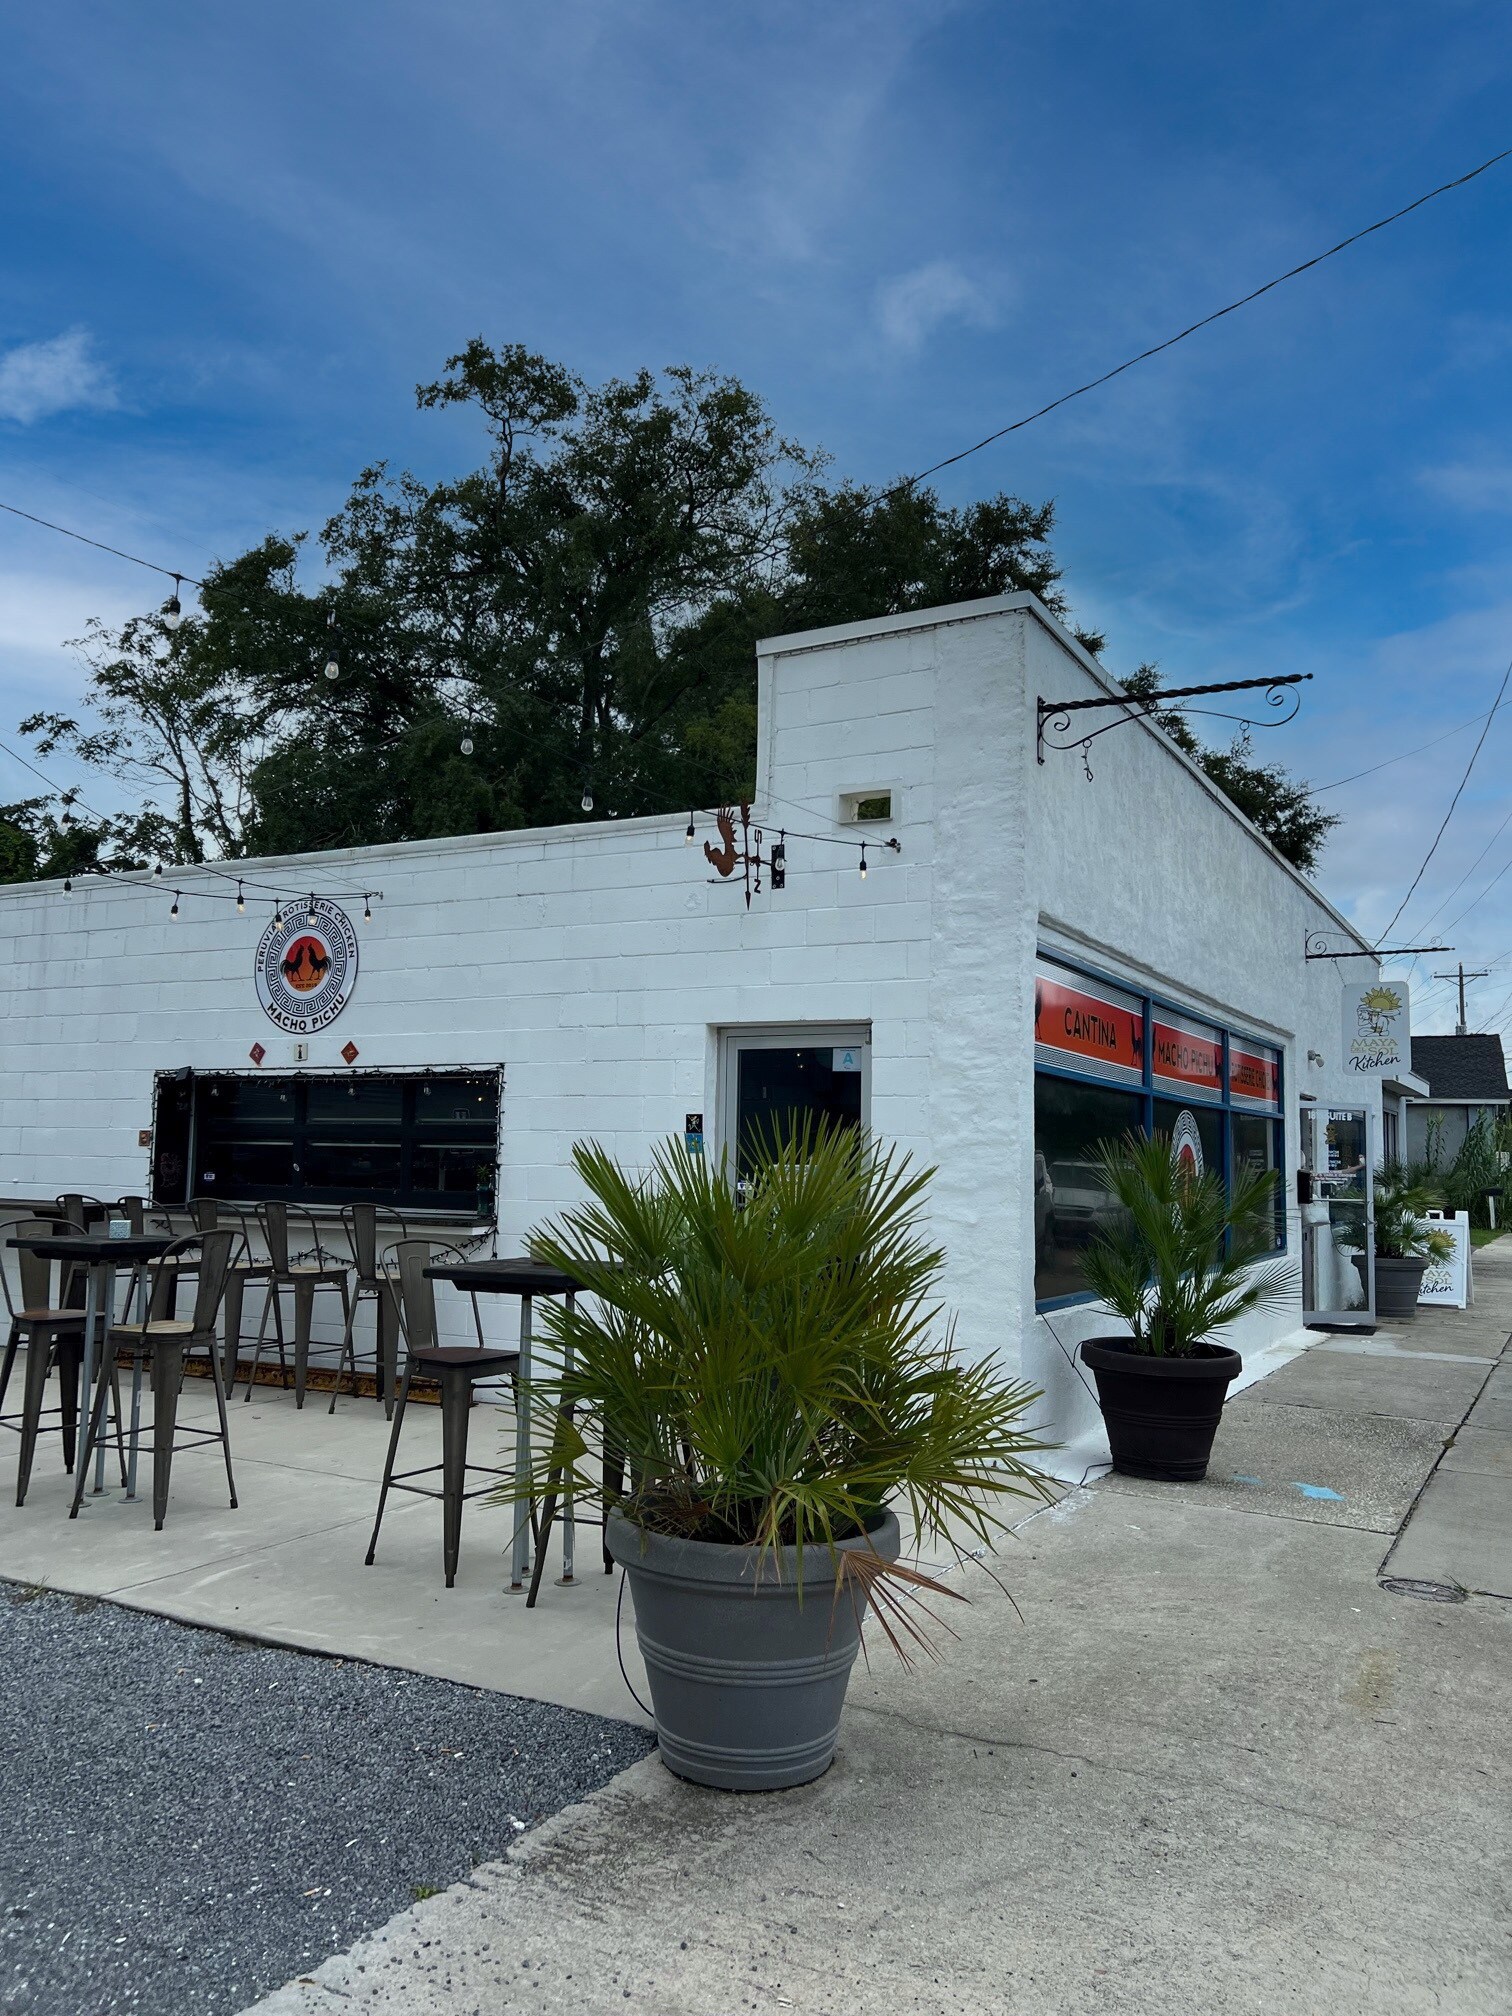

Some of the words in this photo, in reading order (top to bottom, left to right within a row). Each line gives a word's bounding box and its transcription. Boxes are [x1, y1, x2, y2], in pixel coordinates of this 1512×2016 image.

[257, 921, 277, 972] PERUVIA
[282, 901, 334, 918] ROTISSERIE
[334, 912, 355, 958] CHICKEN
[267, 1002, 307, 1031] MACHO
[312, 993, 345, 1029] PICHU
[1064, 1007, 1117, 1050] CANTINA
[1350, 1038, 1398, 1047] MAYA
[842, 1052, 853, 1064] A
[1368, 1047, 1399, 1055] SOL
[1158, 1043, 1189, 1070] MACHO
[1191, 1049, 1214, 1076] PICHU
[1348, 1051, 1401, 1072] Kitchen
[1347, 1112, 1353, 1121] B
[1425, 1276, 1452, 1285] SOL
